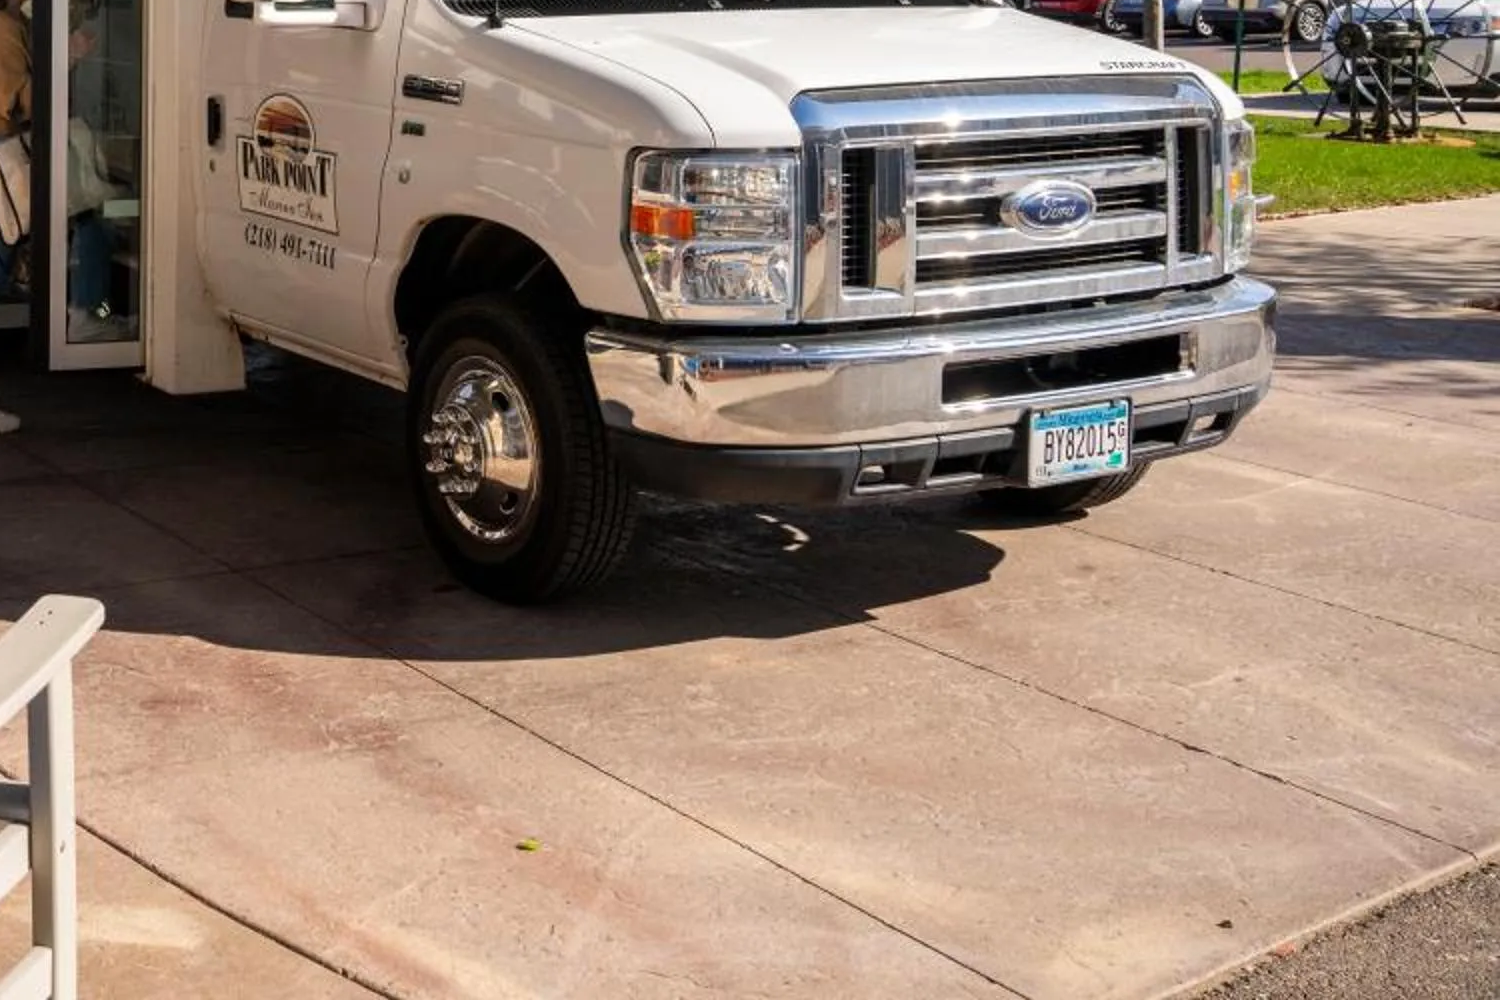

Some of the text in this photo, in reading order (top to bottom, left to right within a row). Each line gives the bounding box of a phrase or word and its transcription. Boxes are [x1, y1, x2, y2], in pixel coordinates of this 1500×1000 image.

[1100, 60, 1187, 71] STARCRAFT
[242, 141, 332, 197] PARK POINT
[1040, 195, 1078, 220] Ford
[244, 222, 337, 270] (218) 491-7111
[1043, 421, 1117, 464] BY82015
